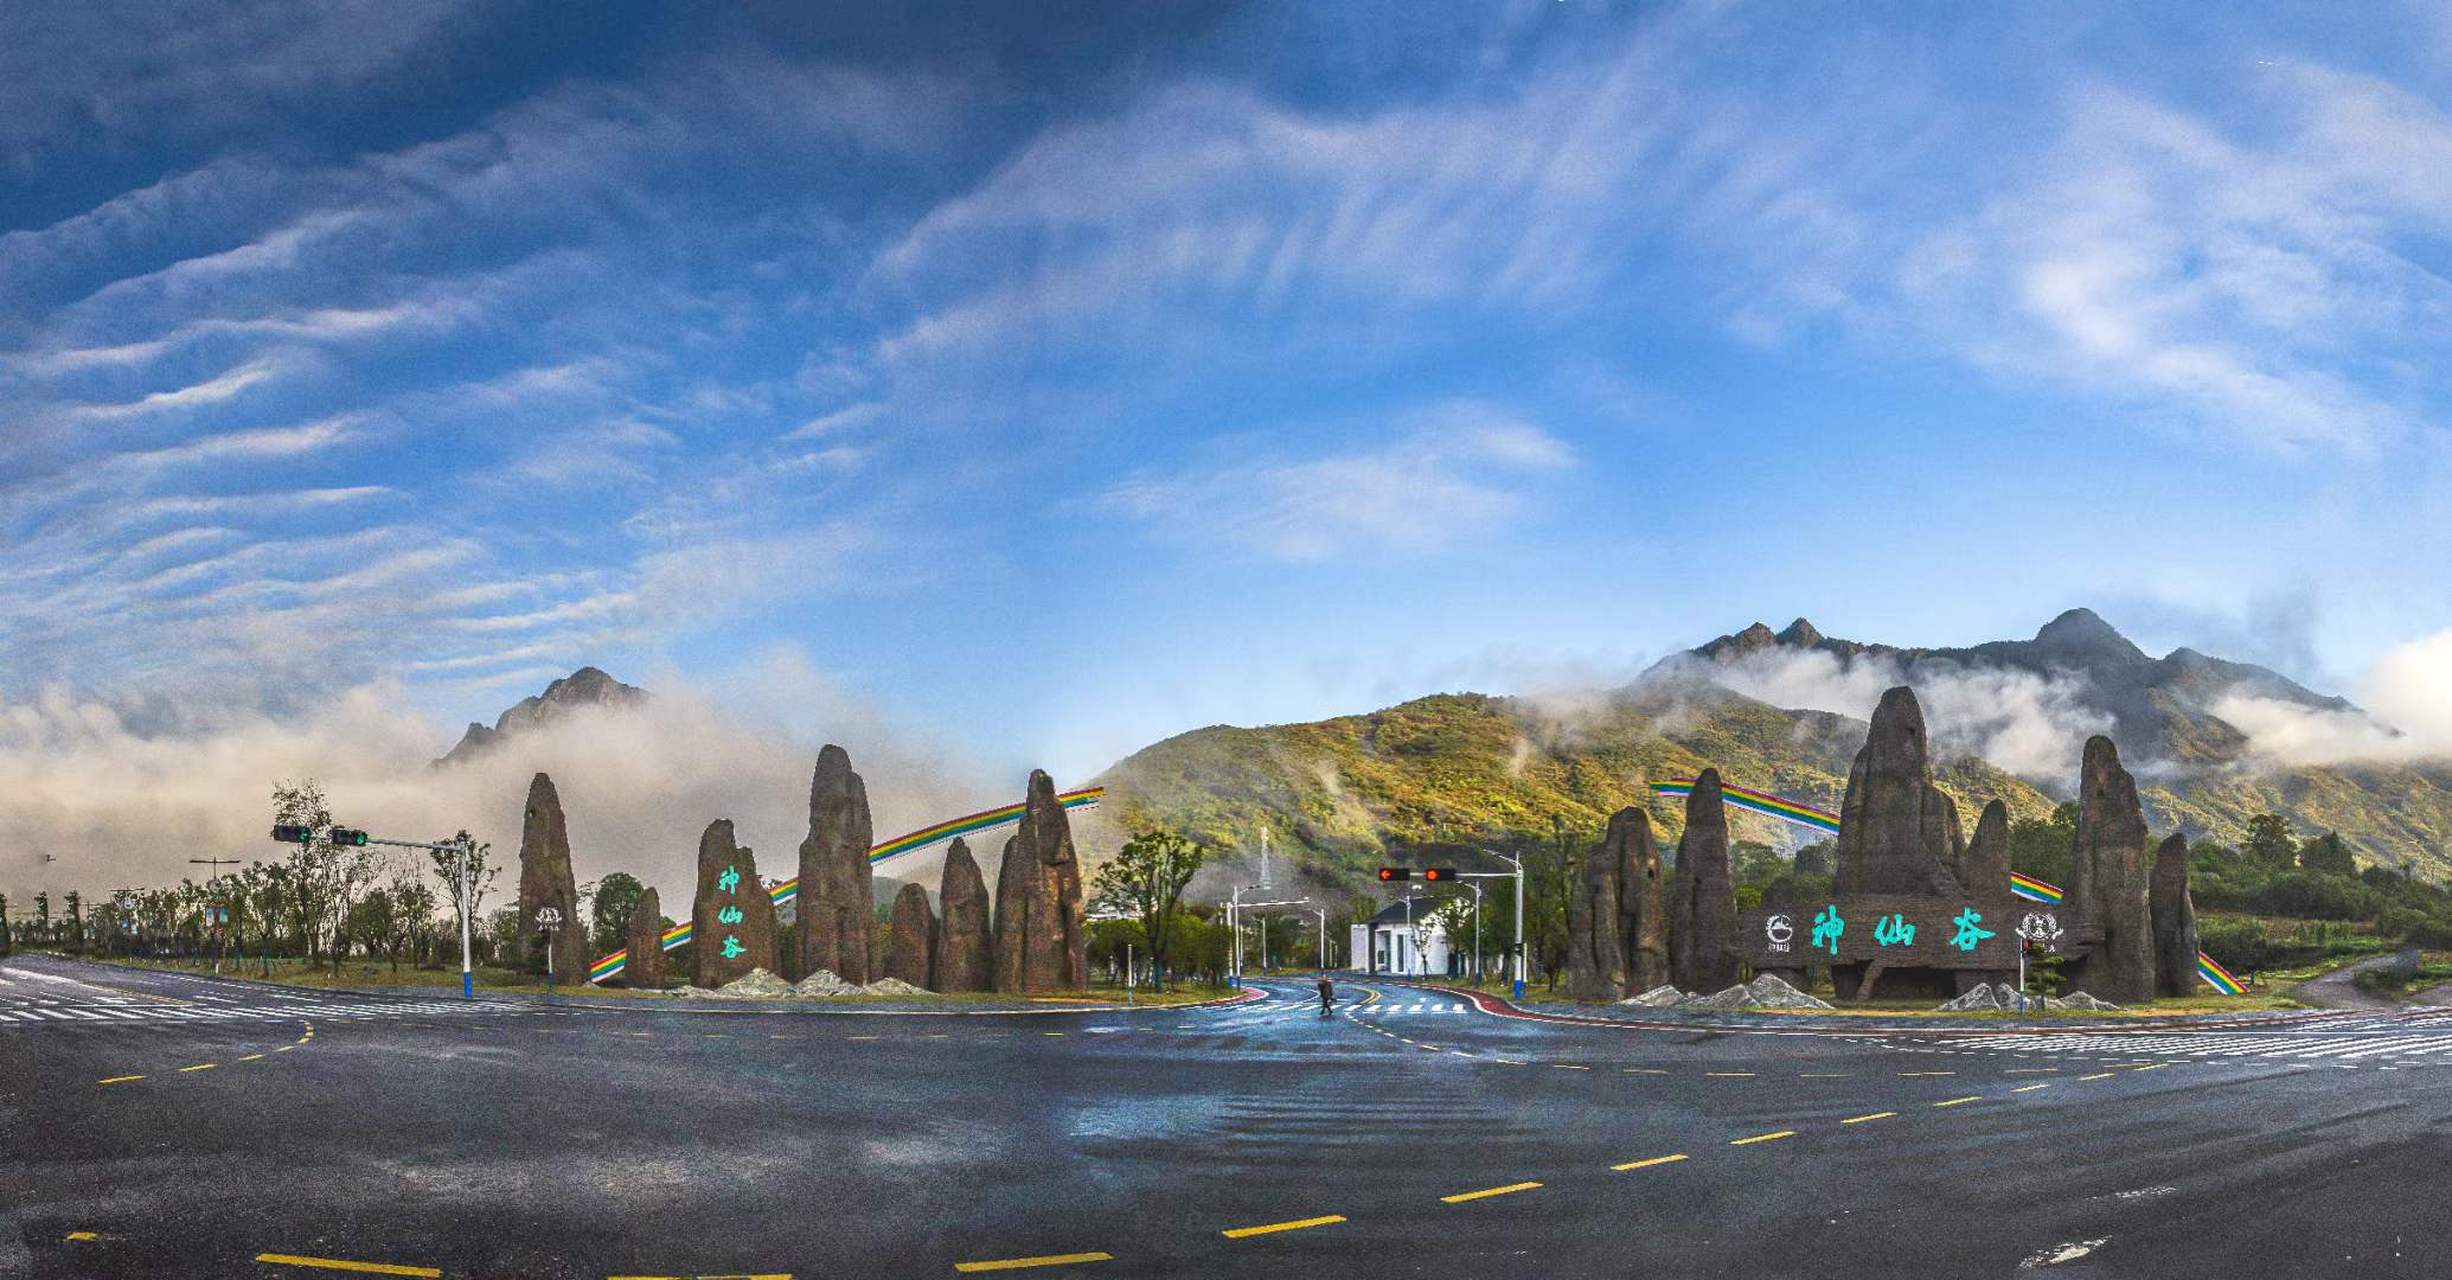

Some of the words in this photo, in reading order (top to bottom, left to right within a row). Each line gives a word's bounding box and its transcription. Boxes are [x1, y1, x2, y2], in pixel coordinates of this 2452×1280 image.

[718, 864, 747, 959] 神仙谷
[1812, 904, 1997, 955] 神仙谷
